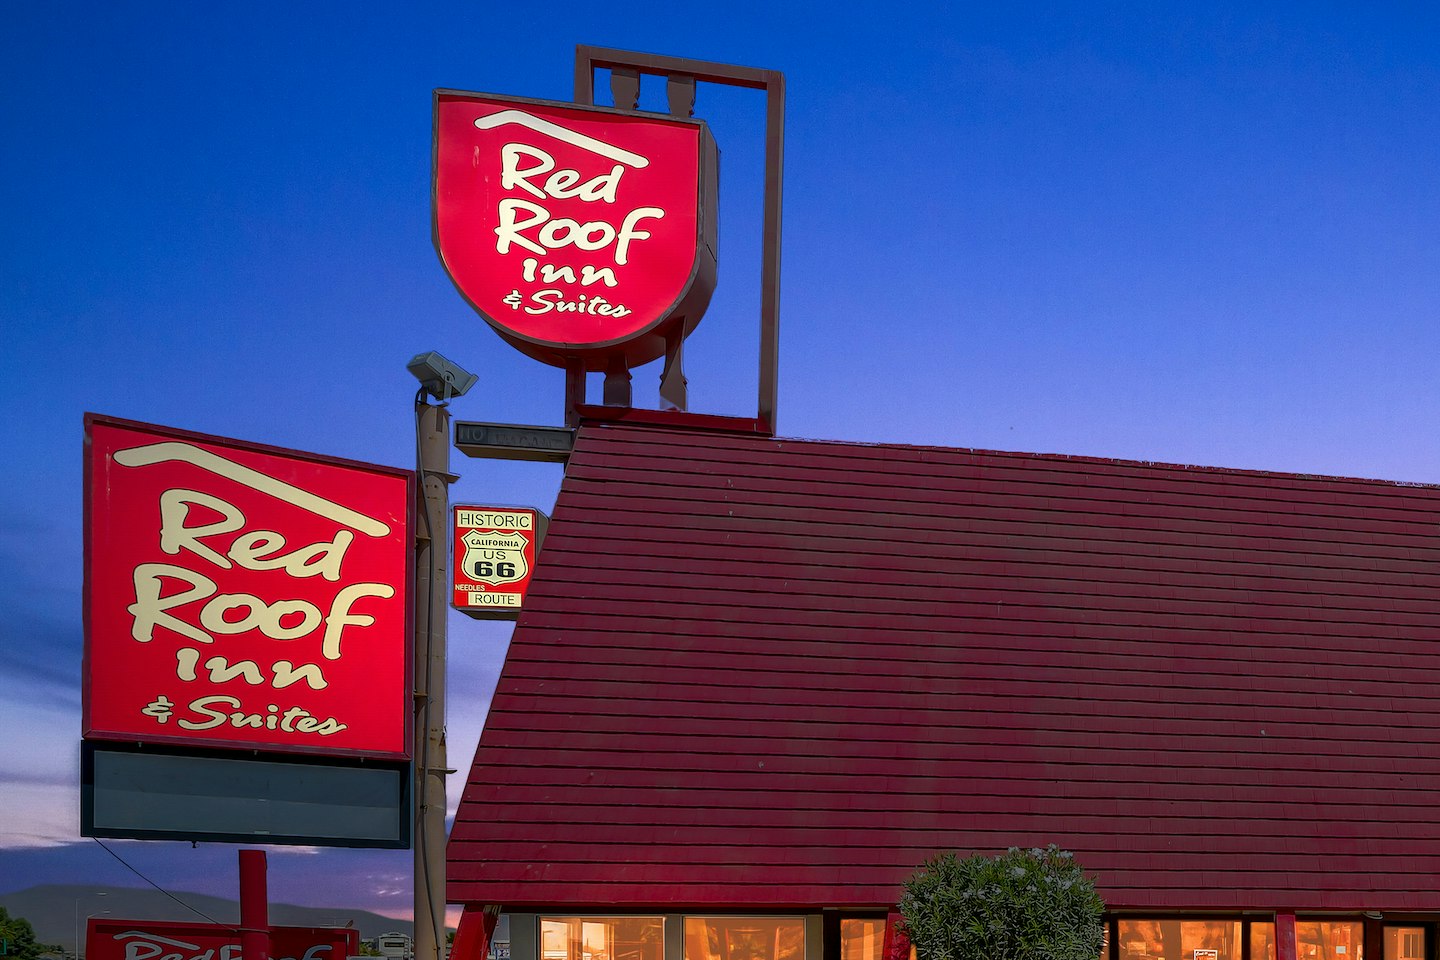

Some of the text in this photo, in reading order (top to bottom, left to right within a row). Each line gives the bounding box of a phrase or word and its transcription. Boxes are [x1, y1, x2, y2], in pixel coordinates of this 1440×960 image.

[501, 143, 625, 204] Red
[493, 198, 665, 266] Roof
[522, 258, 618, 288] Inn
[502, 289, 632, 318] & Suites
[159, 488, 354, 582] Red
[460, 513, 530, 528] HISTORIC
[471, 538, 519, 547] CALIFORNIA
[483, 551, 506, 560] US
[474, 561, 516, 578] 66
[127, 563, 396, 660] Roof
[475, 594, 515, 605] ROUTE
[176, 647, 329, 690] Inn
[141, 695, 348, 736] & Suites
